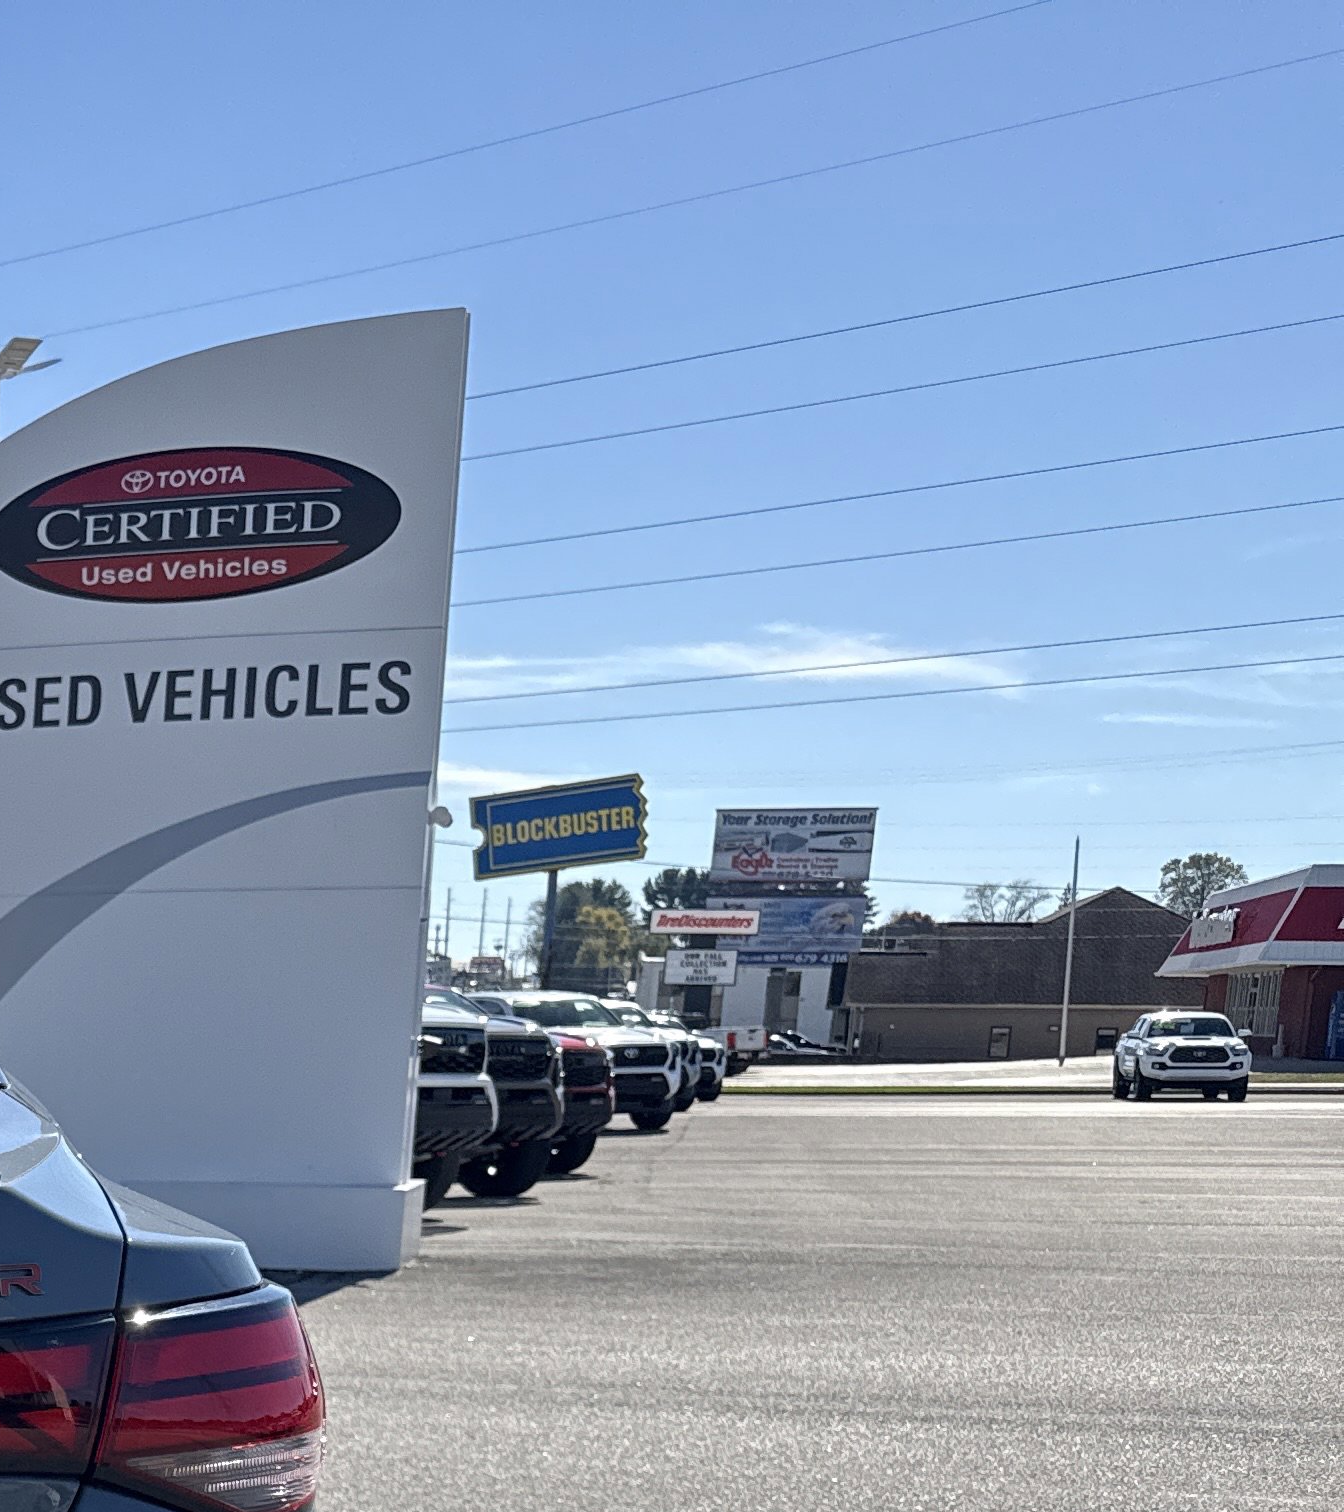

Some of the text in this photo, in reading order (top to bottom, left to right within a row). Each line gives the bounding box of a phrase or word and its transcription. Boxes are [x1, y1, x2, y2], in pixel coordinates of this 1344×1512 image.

[156, 465, 246, 489] TOYOTA
[36, 501, 342, 551] CERTIFIED
[81, 556, 288, 586] Used Vehicles
[124, 660, 412, 724] VEHICLES
[491, 806, 635, 847] BLOCKBUSTER
[721, 812, 873, 828] Your Storage Solution!
